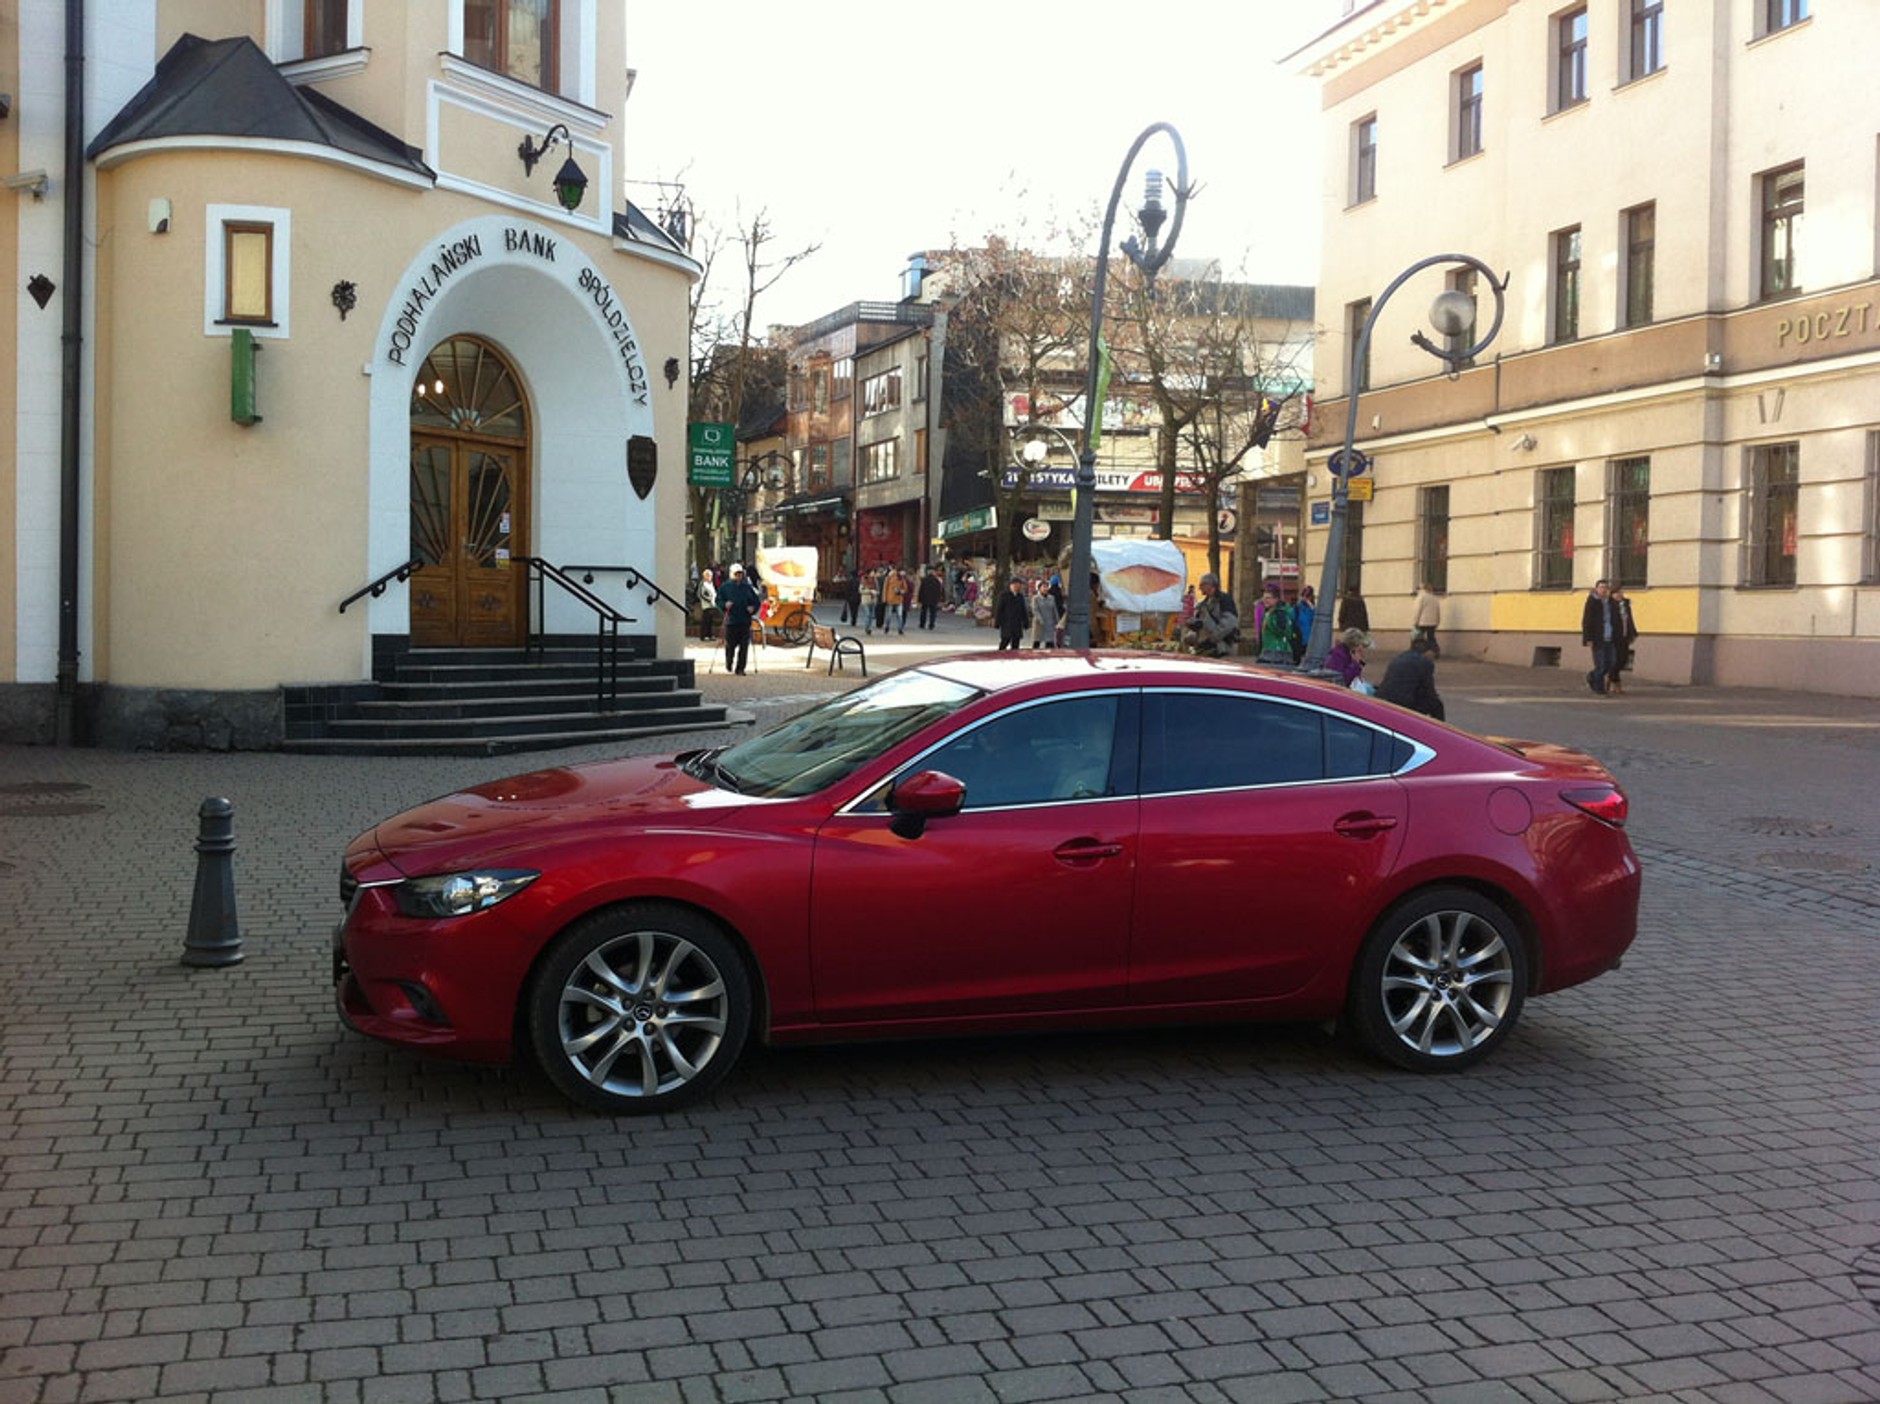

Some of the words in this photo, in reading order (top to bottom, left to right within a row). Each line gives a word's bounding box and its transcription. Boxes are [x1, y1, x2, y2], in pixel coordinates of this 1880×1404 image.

[387, 233, 483, 367] PODHALAŃSKI
[504, 227, 557, 262] BANK
[1777, 301, 1880, 348] POCZT
[694, 455, 729, 468] BANK
[1006, 471, 1076, 484] TSTYKA
[1096, 474, 1130, 486] ILETY
